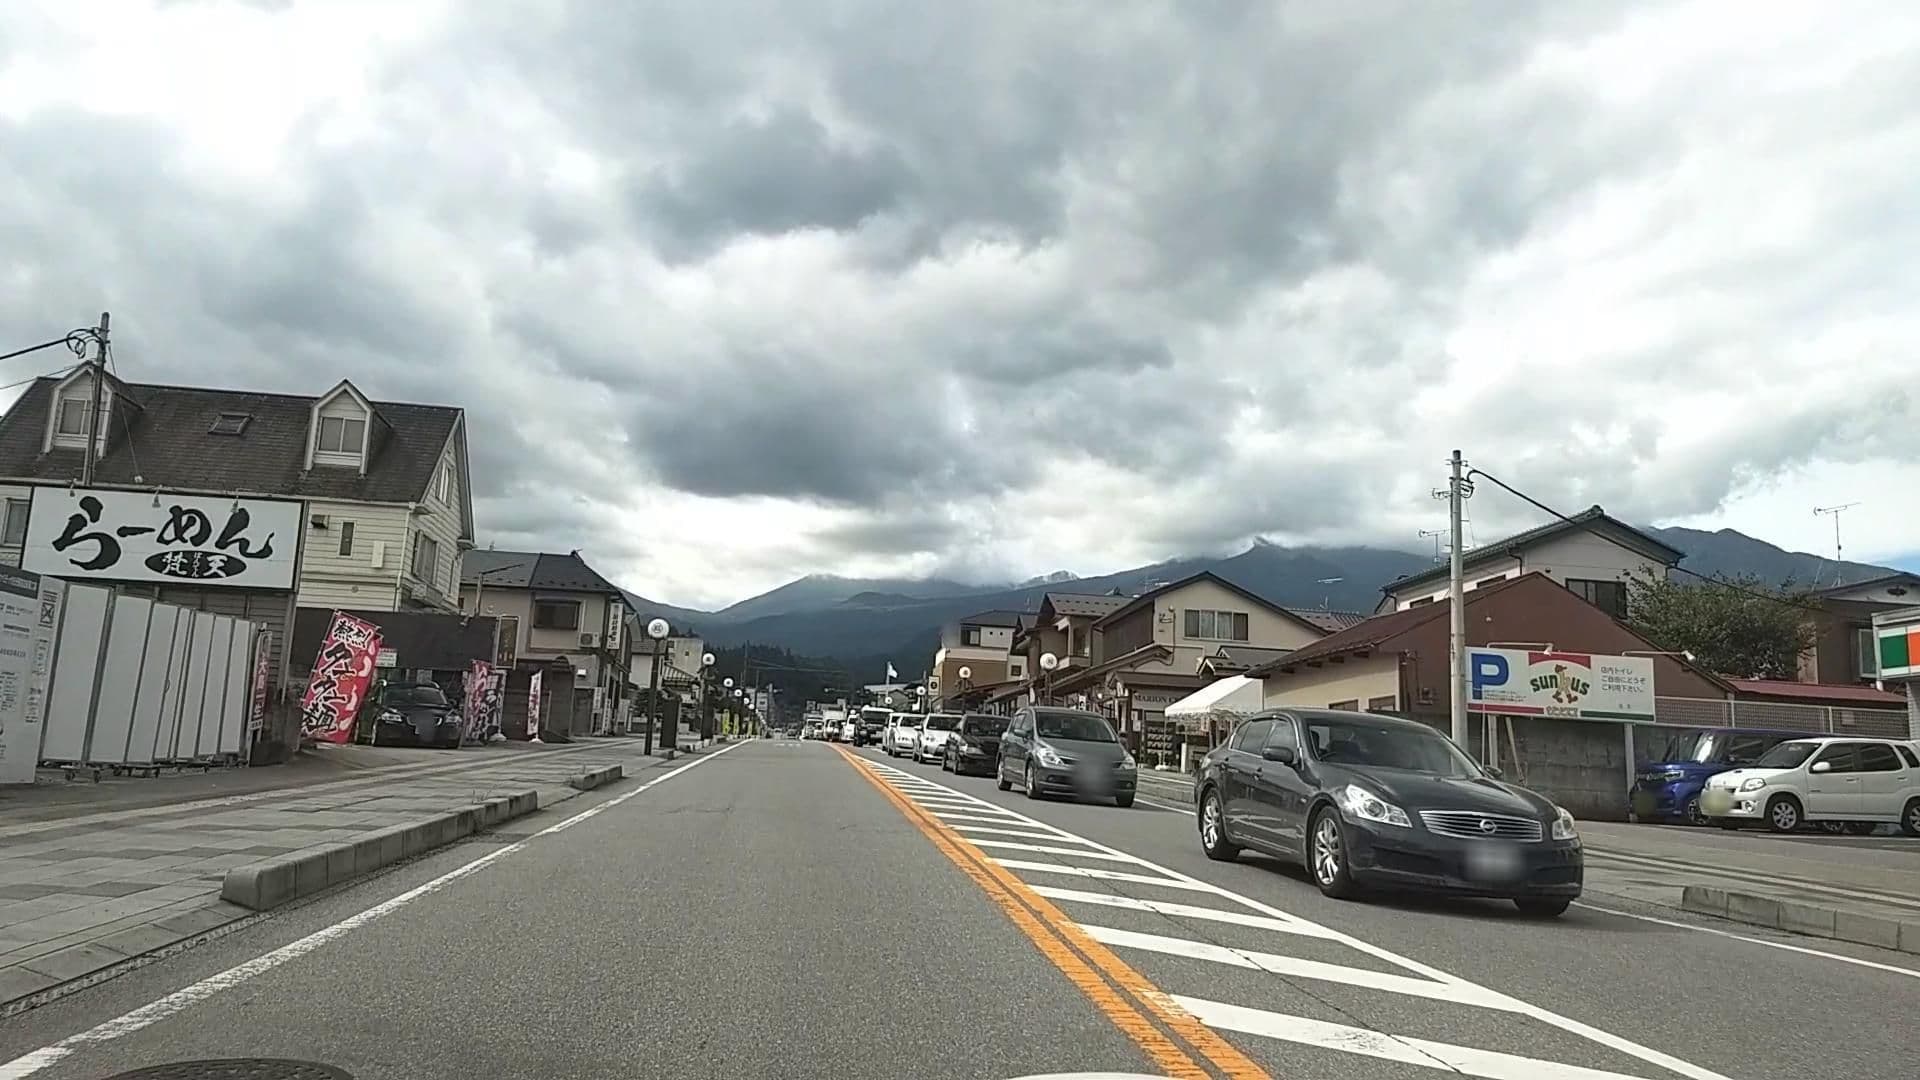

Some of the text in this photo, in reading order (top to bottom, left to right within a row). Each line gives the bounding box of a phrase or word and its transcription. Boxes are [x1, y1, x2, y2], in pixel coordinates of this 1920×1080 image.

[52, 496, 275, 571] らーめん
[1471, 653, 1509, 700] P
